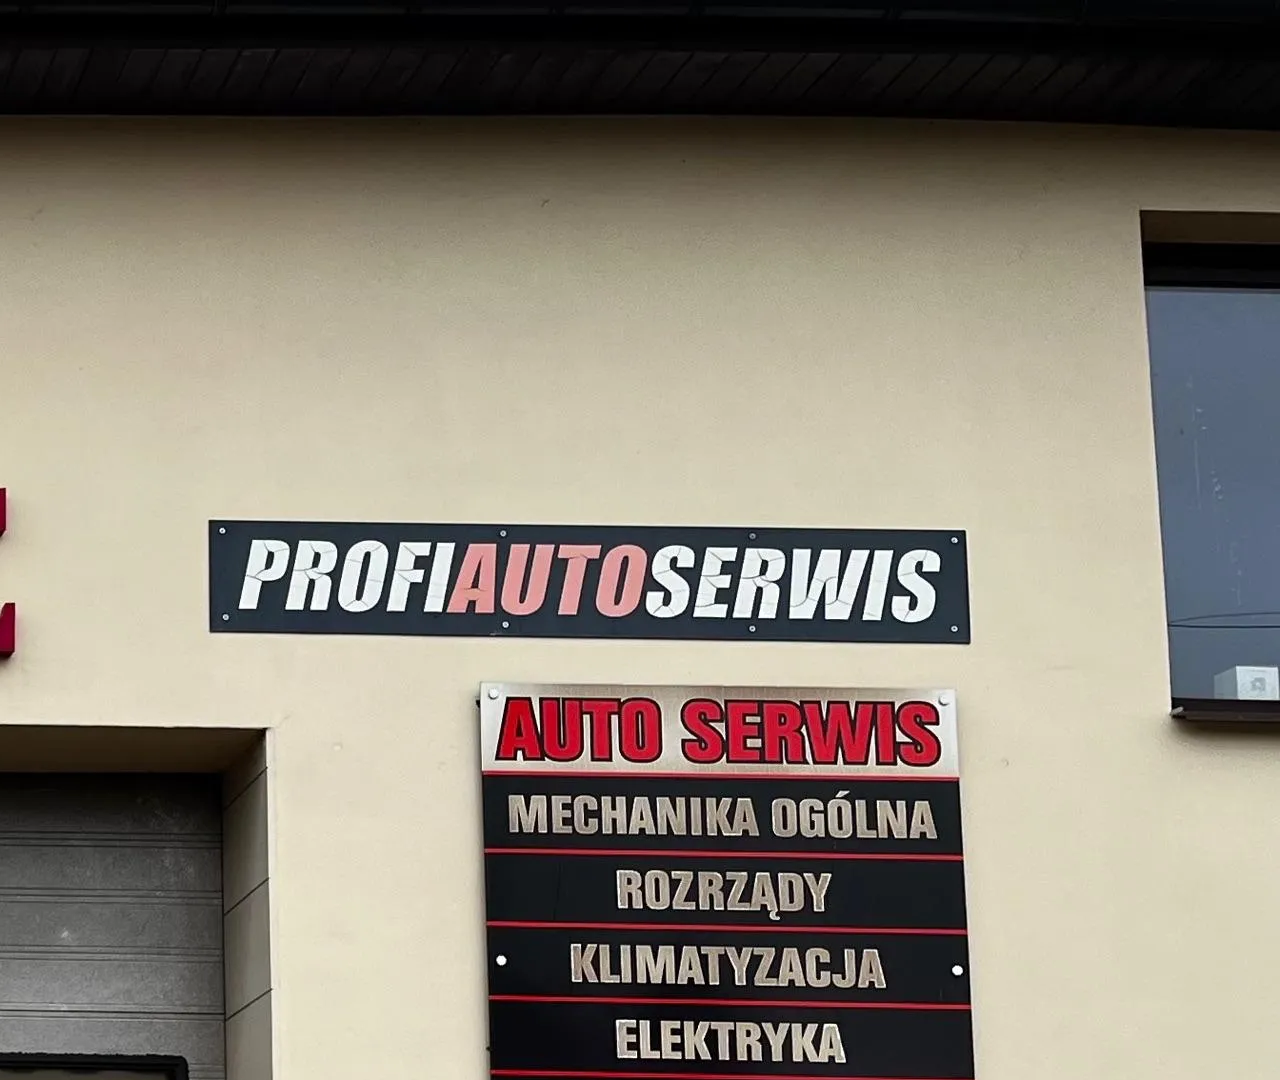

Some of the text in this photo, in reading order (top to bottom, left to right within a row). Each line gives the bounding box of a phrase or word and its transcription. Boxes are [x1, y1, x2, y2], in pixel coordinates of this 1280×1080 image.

[237, 539, 942, 623] PROFIAUTOSERWIS
[495, 696, 943, 767] AUTO SERWIS
[507, 790, 938, 839] MECHANIKA OGÓLNA
[615, 869, 832, 920] ROZRZĄDY
[570, 943, 886, 989] KLIMATYZACJA
[615, 1018, 846, 1063] ELEKTRYKA
